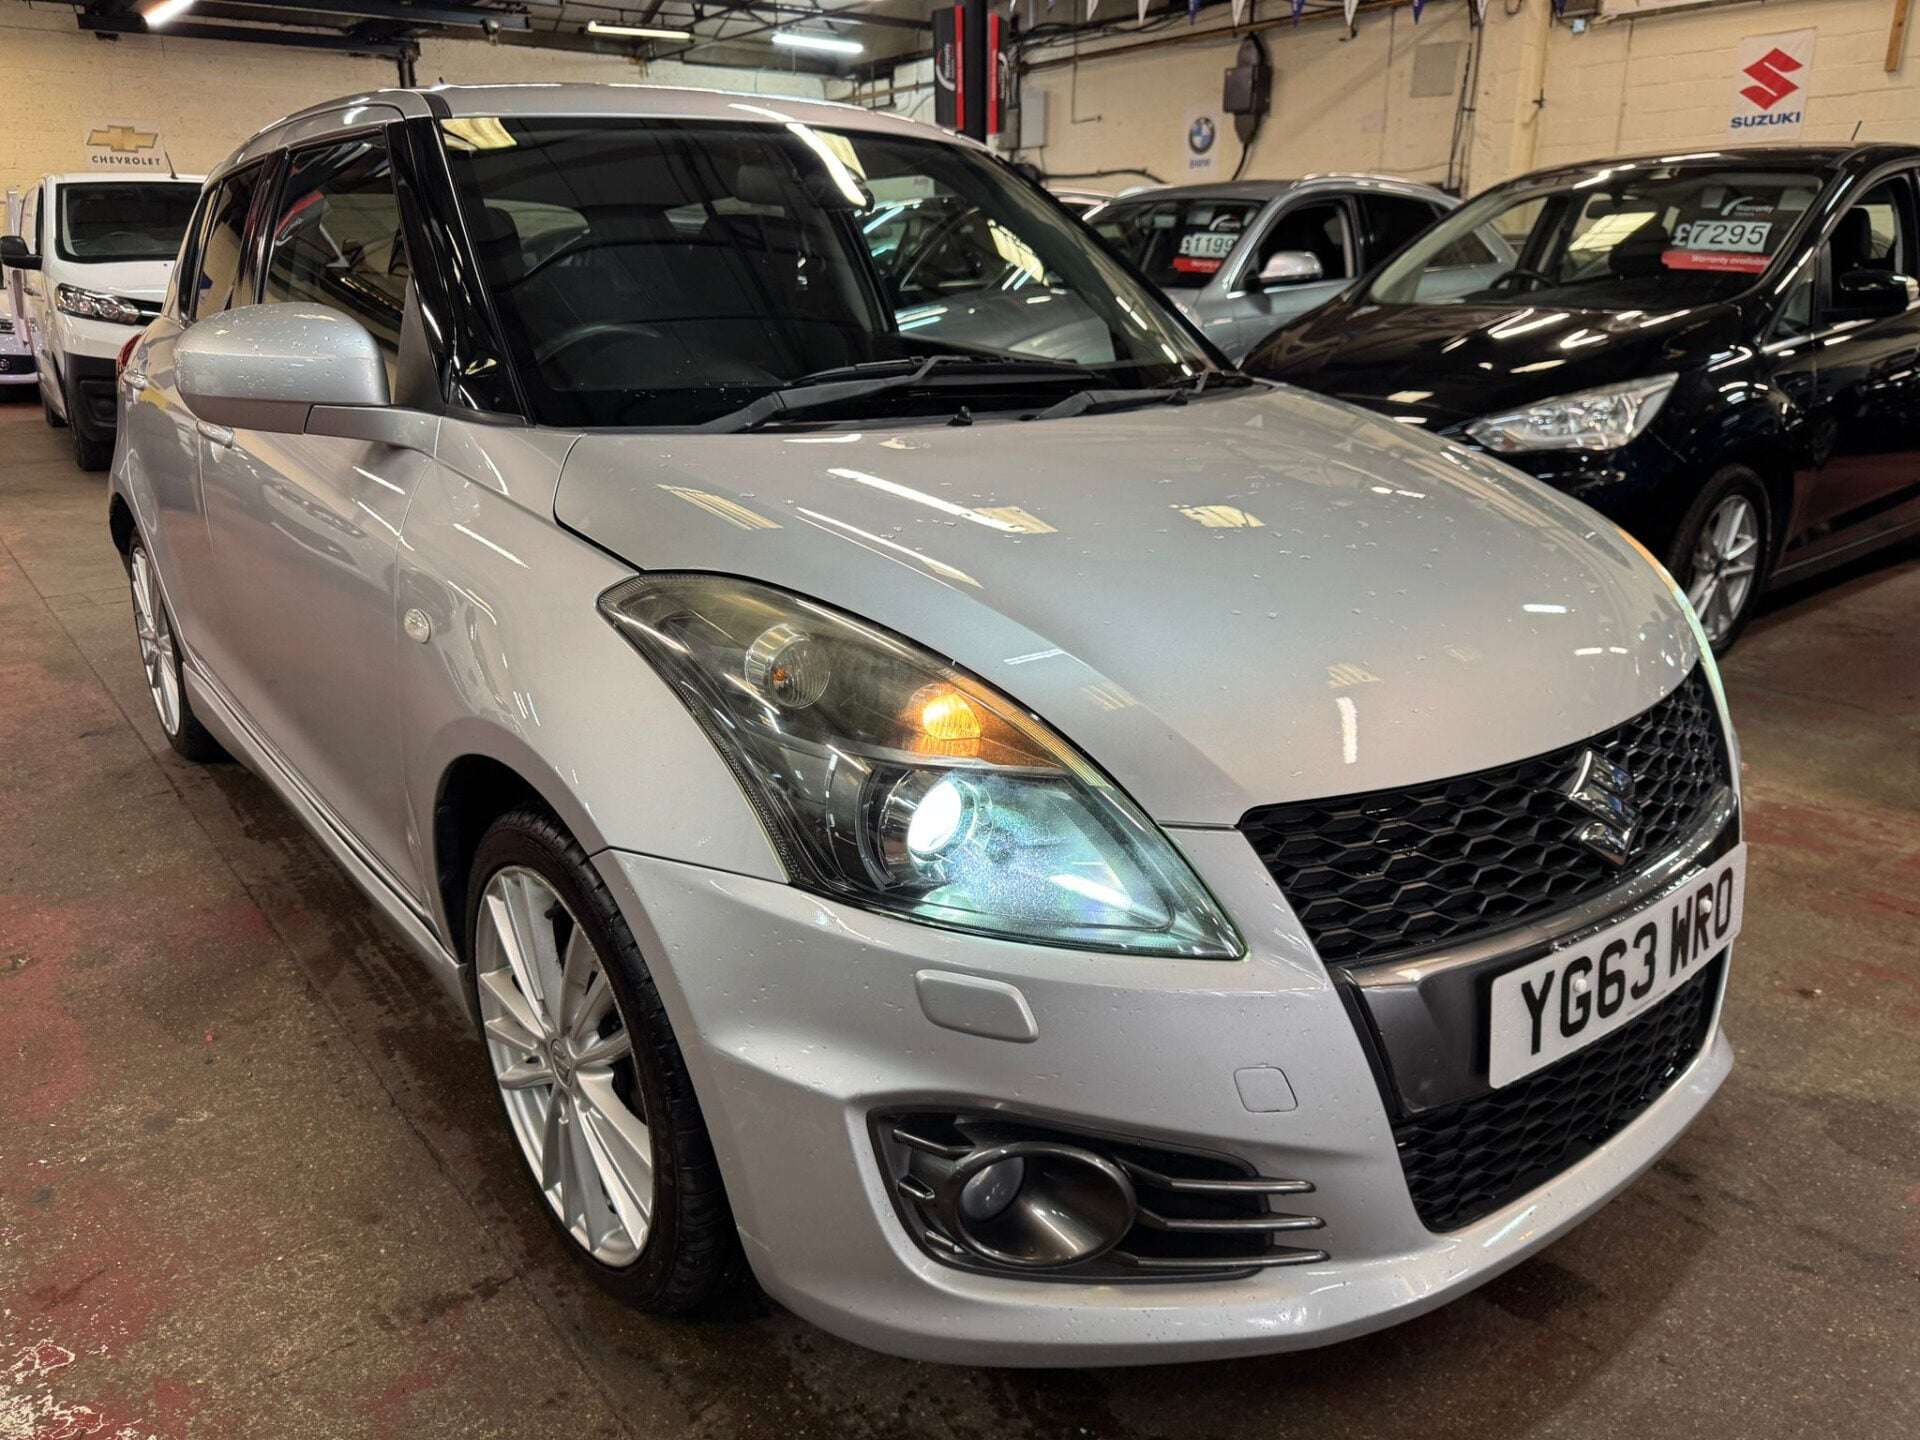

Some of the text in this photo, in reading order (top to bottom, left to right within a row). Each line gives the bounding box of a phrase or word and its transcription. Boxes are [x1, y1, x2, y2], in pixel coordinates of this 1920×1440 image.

[1731, 112, 1801, 128] SUZUKI
[92, 155, 160, 165] CHEVROLET
[1671, 222, 1767, 246] £7295
[1521, 866, 1734, 1056] YG63 WRO
